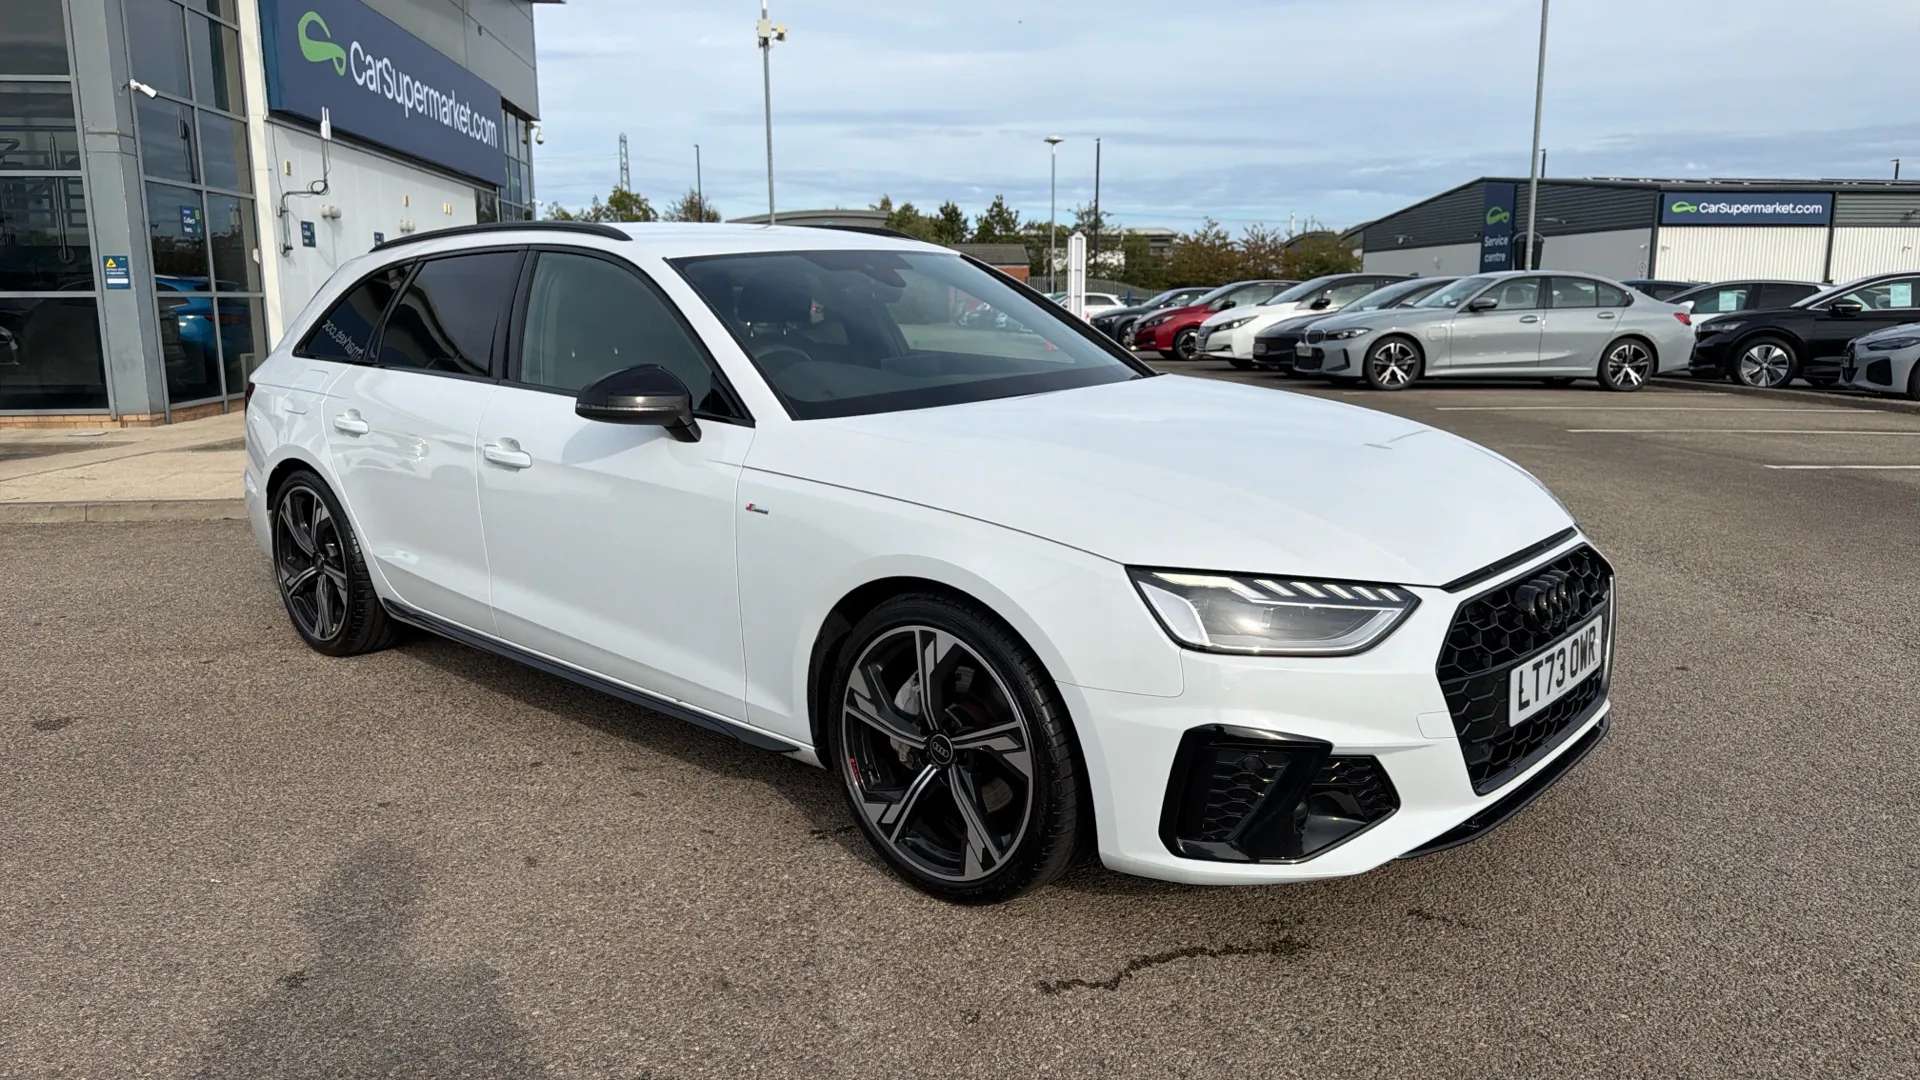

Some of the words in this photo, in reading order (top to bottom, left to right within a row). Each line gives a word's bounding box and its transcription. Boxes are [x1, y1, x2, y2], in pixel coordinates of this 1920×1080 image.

[350, 41, 498, 149] CarSupermarket.com
[1699, 202, 1822, 216] CarSupermarket.com
[1484, 234, 1509, 247] Service
[1484, 252, 1506, 263] centre
[1518, 648, 1566, 711] LT73
[1570, 626, 1597, 678] OWR
